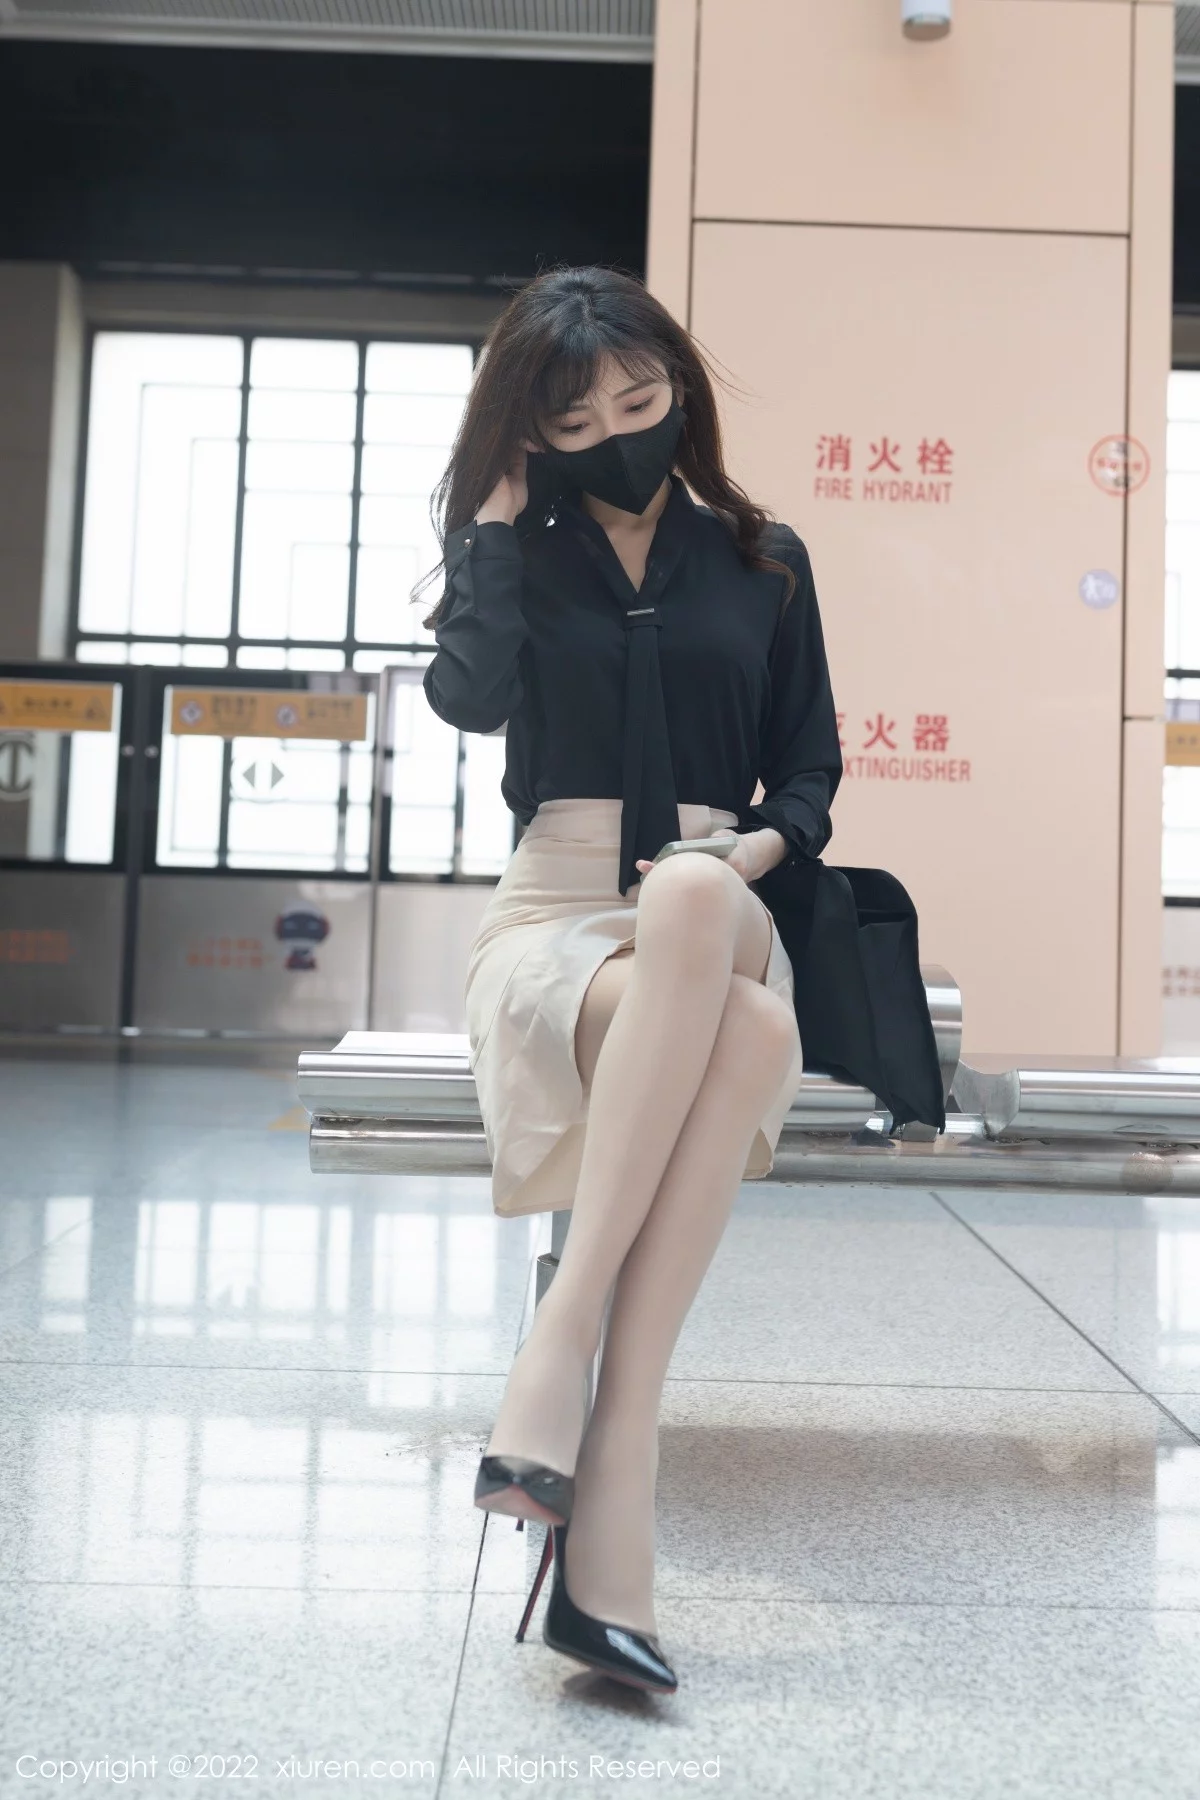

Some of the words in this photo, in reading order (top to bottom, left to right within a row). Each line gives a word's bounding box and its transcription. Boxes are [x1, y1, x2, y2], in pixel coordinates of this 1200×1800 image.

[816, 432, 954, 475] 消火栓
[814, 477, 853, 500] FIRE
[863, 479, 952, 503] HYDRANT
[843, 756, 971, 782] XTINGUISHER
